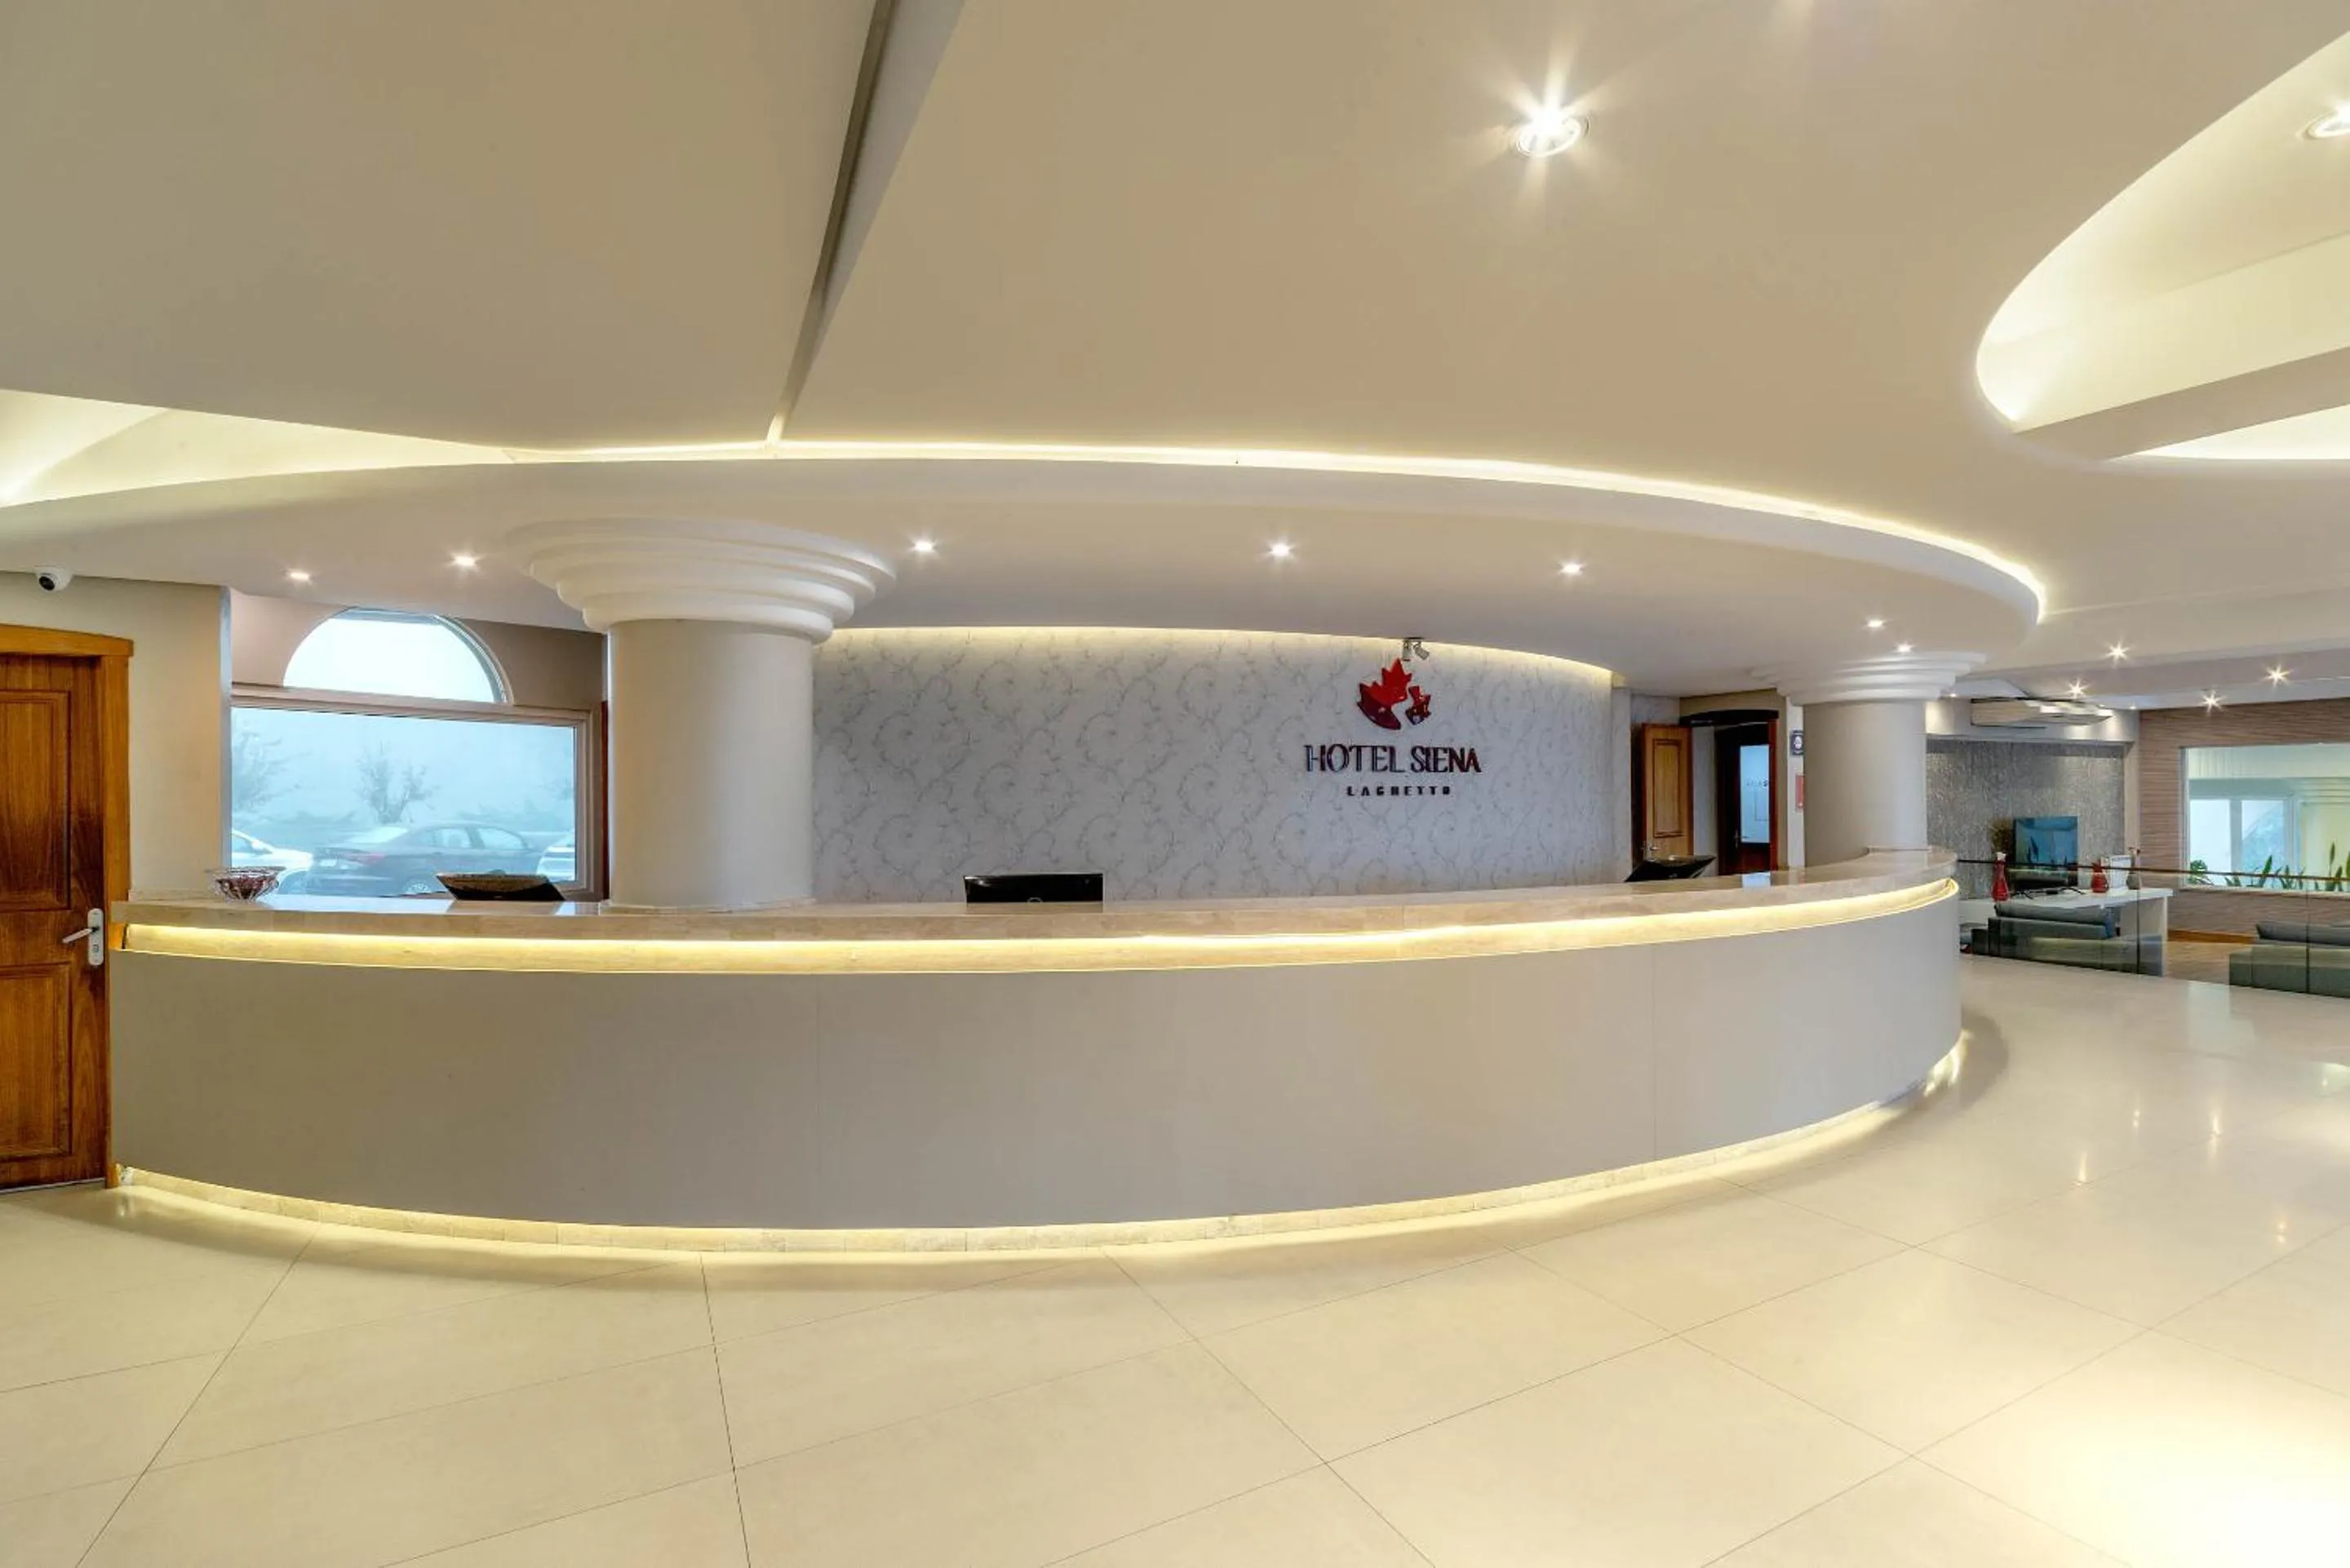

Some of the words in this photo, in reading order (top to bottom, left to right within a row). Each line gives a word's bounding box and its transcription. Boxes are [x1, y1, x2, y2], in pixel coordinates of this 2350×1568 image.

[1304, 743, 1406, 773] HOTEL
[1410, 745, 1482, 773] SIENA
[1347, 786, 1451, 796] LAGHETTO
